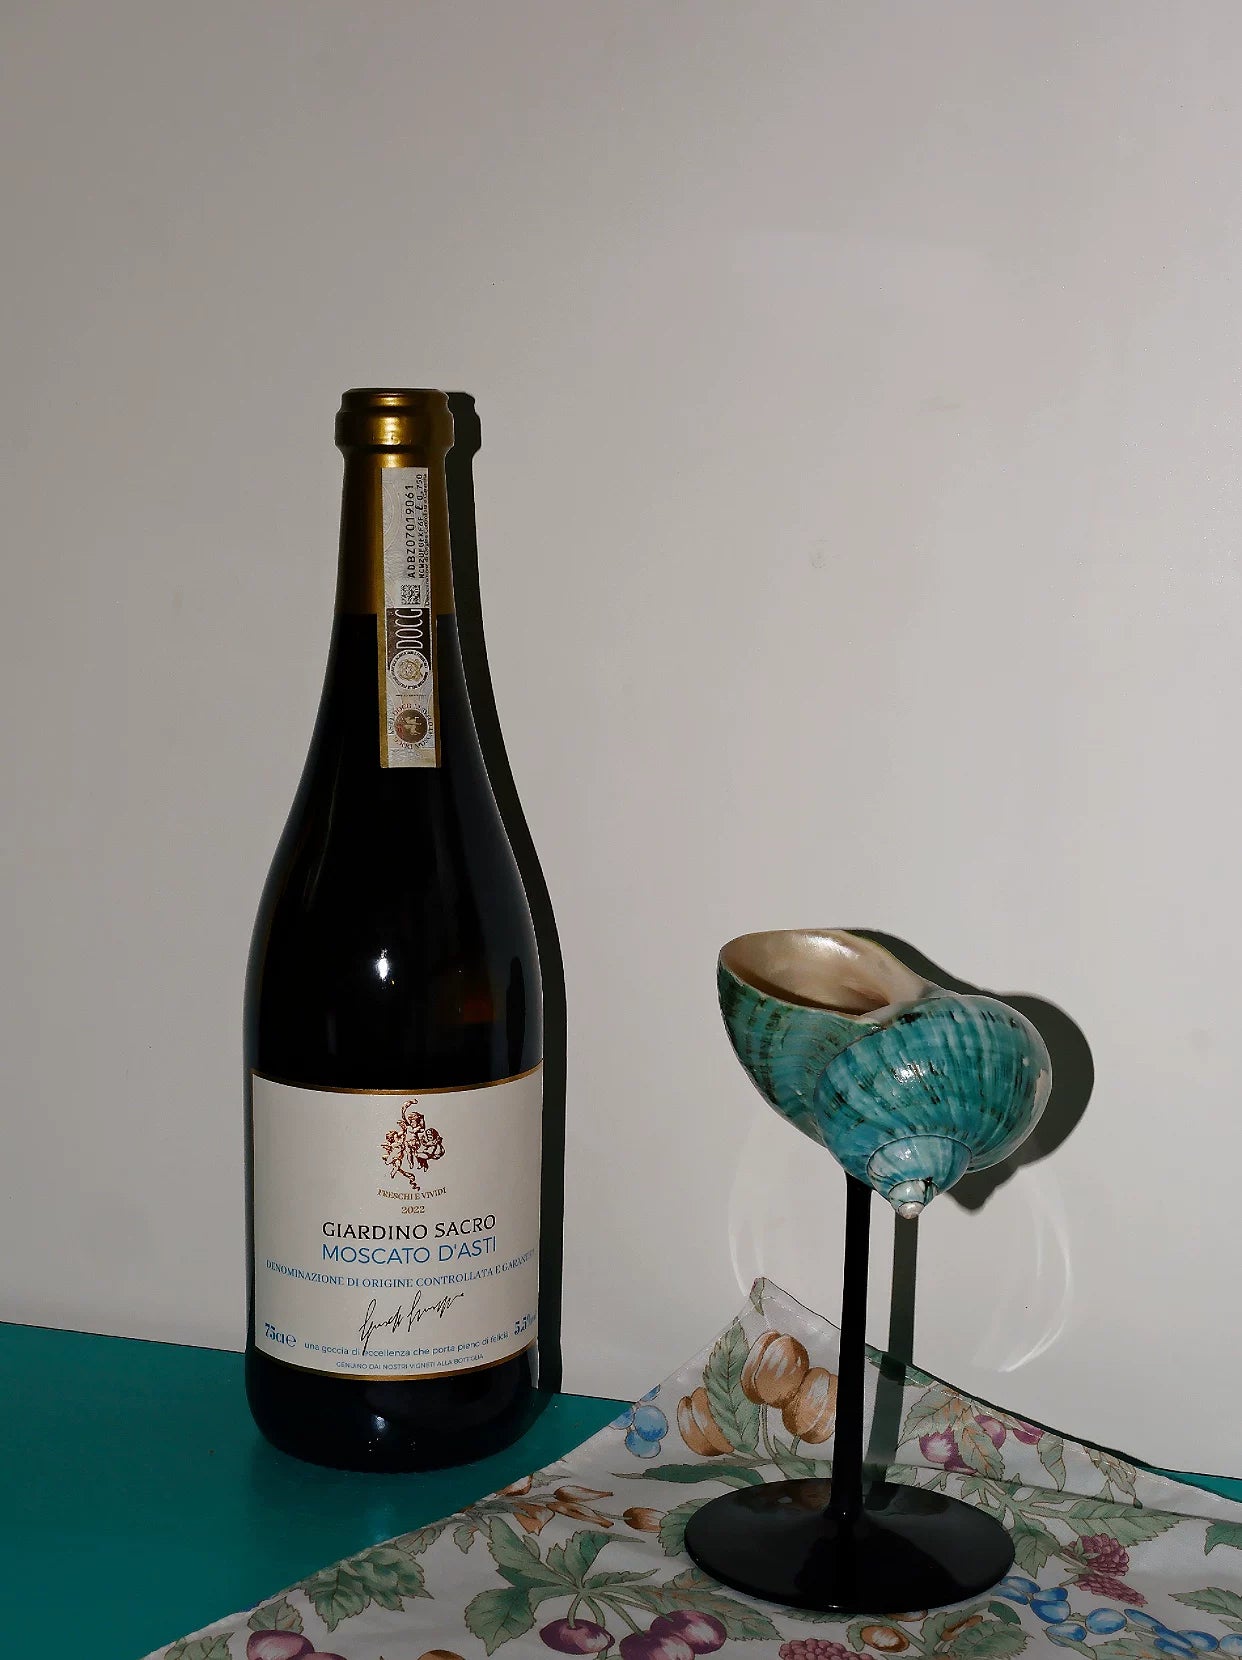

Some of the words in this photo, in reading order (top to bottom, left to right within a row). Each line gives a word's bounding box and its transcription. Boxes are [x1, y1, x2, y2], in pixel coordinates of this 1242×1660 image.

[405, 484, 416, 579] ADBZ07019061
[395, 608, 424, 649] DOCG
[377, 1189, 413, 1200] FRESCHI
[421, 1186, 447, 1199] VIVIDI
[401, 1205, 425, 1214] 2022
[322, 1221, 428, 1240] GIARDINO
[434, 1214, 496, 1238] SACRO
[322, 1243, 430, 1265] MOSCATO
[438, 1236, 496, 1262] D'ASTI
[266, 1259, 345, 1285] DENOMINAZIONE
[347, 1277, 359, 1287] DI
[362, 1278, 413, 1288] ORIGINE
[415, 1267, 494, 1287] CONTROLLATA
[495, 1264, 501, 1275] E
[304, 1342, 320, 1351] una
[321, 1345, 349, 1355] goccia
[363, 1348, 411, 1357] eccellenza
[413, 1347, 430, 1356] che
[432, 1344, 455, 1355] porta
[482, 1337, 490, 1346] di
[336, 1361, 368, 1370] GENUINO
[409, 1361, 435, 1369] VIGNETI
[437, 1359, 453, 1367] ALLA
